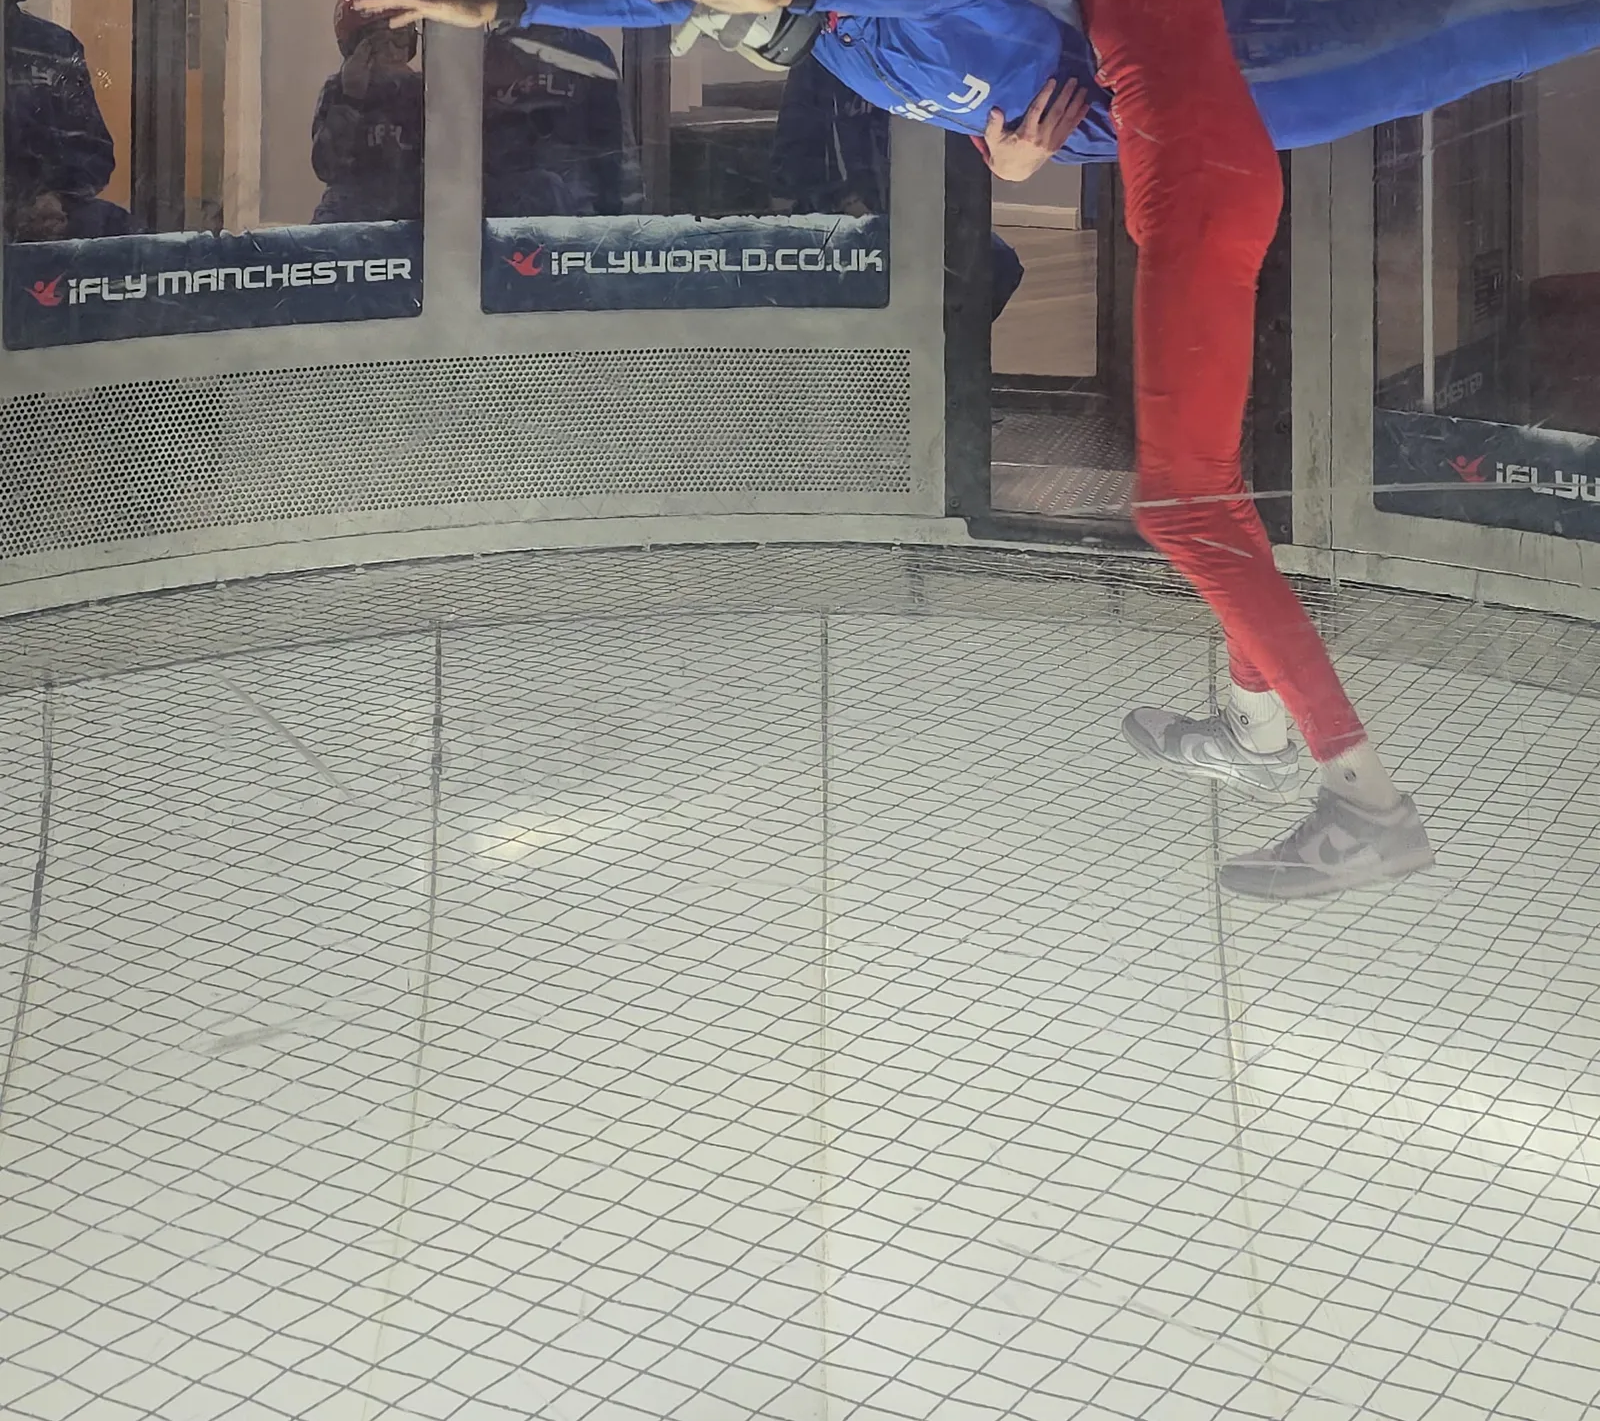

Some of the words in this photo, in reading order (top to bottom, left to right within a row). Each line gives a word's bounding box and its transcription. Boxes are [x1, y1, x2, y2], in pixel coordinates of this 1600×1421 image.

[550, 247, 883, 276] iFLYWORLD.CO.UK
[68, 273, 147, 305] iFLY
[157, 258, 411, 297] MANCHESTER
